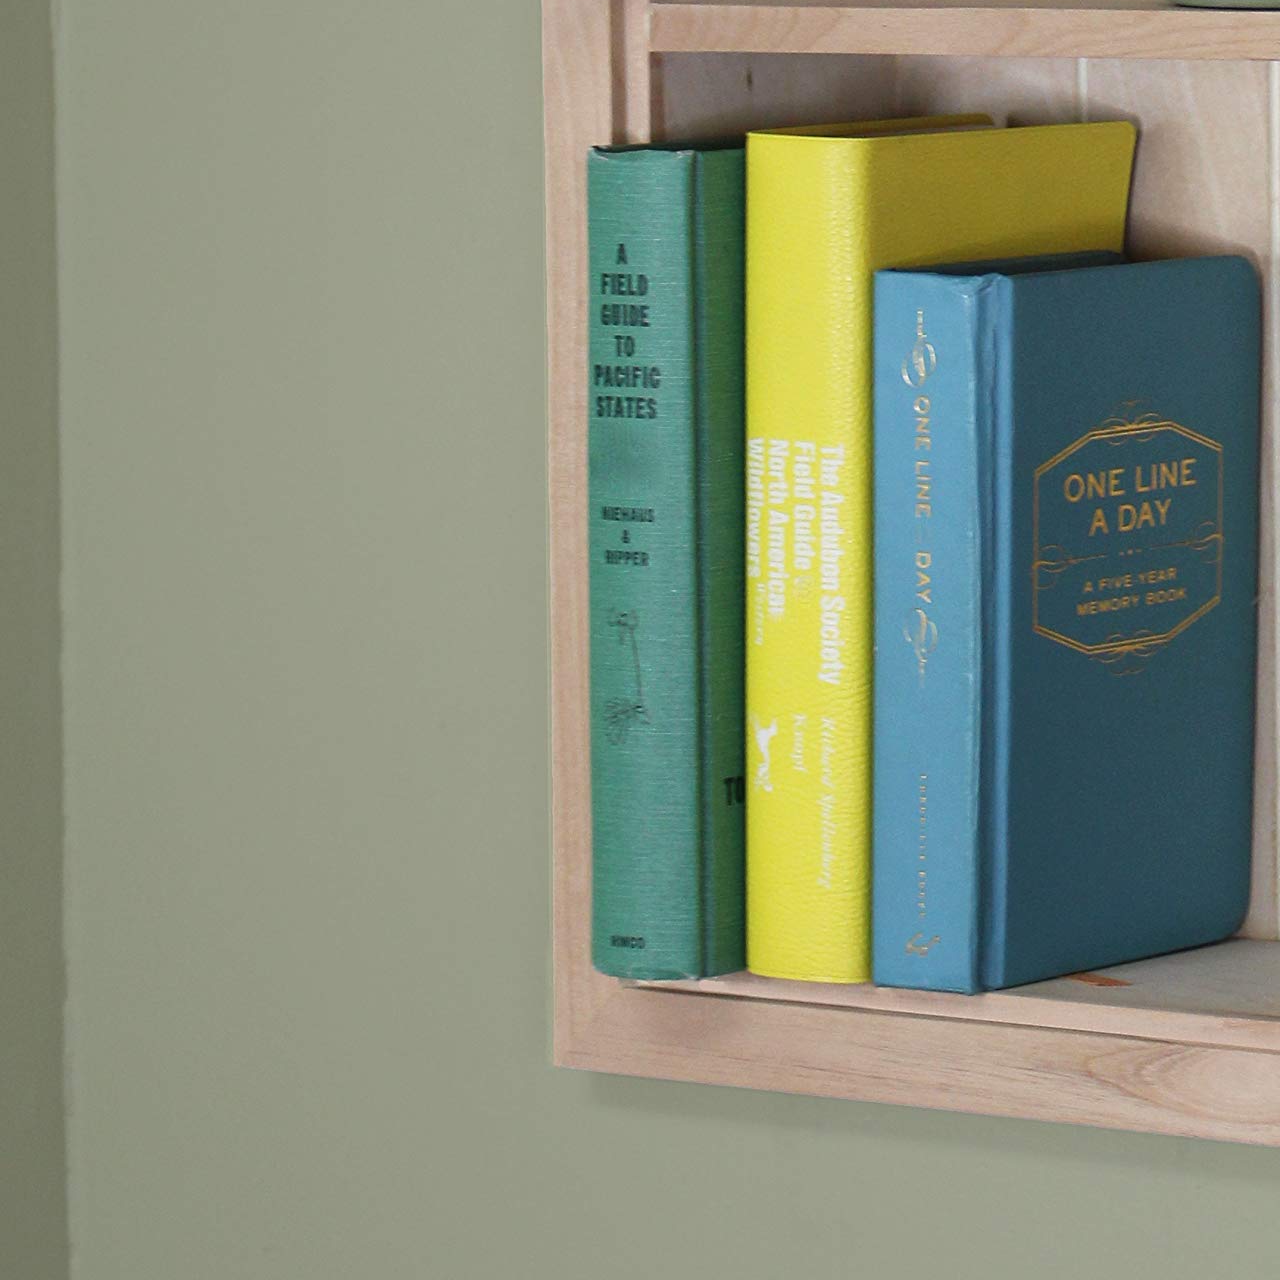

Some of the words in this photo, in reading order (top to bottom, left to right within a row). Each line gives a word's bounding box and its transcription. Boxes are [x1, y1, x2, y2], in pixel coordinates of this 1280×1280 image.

[616, 243, 628, 265] A
[601, 273, 649, 297] FIELD
[602, 304, 650, 327] GUIDE
[614, 335, 635, 357] TO
[594, 364, 661, 389] PACIFIC
[596, 395, 657, 419] STATES
[914, 394, 931, 451] ONE
[768, 439, 790, 504] North
[794, 440, 816, 500] Field
[820, 443, 845, 487] The
[1064, 468, 1125, 503] ONE
[1136, 458, 1197, 492] LINE
[914, 459, 932, 518] LINE
[602, 506, 655, 522] NIEHAUS
[747, 437, 764, 578] Wildflowers
[1088, 508, 1109, 536] A
[1118, 499, 1172, 532] DAY
[621, 529, 631, 544] &
[793, 504, 816, 571] Guide
[820, 490, 845, 591] Audubon
[605, 549, 649, 566] RIPPER
[915, 551, 932, 604] DAY
[1083, 581, 1094, 593] A
[1099, 574, 1134, 591] FIVE
[1139, 567, 1177, 586] YEAR
[1077, 594, 1139, 616] MEMORY
[1146, 587, 1187, 605] BOOK
[818, 595, 846, 686] Society
